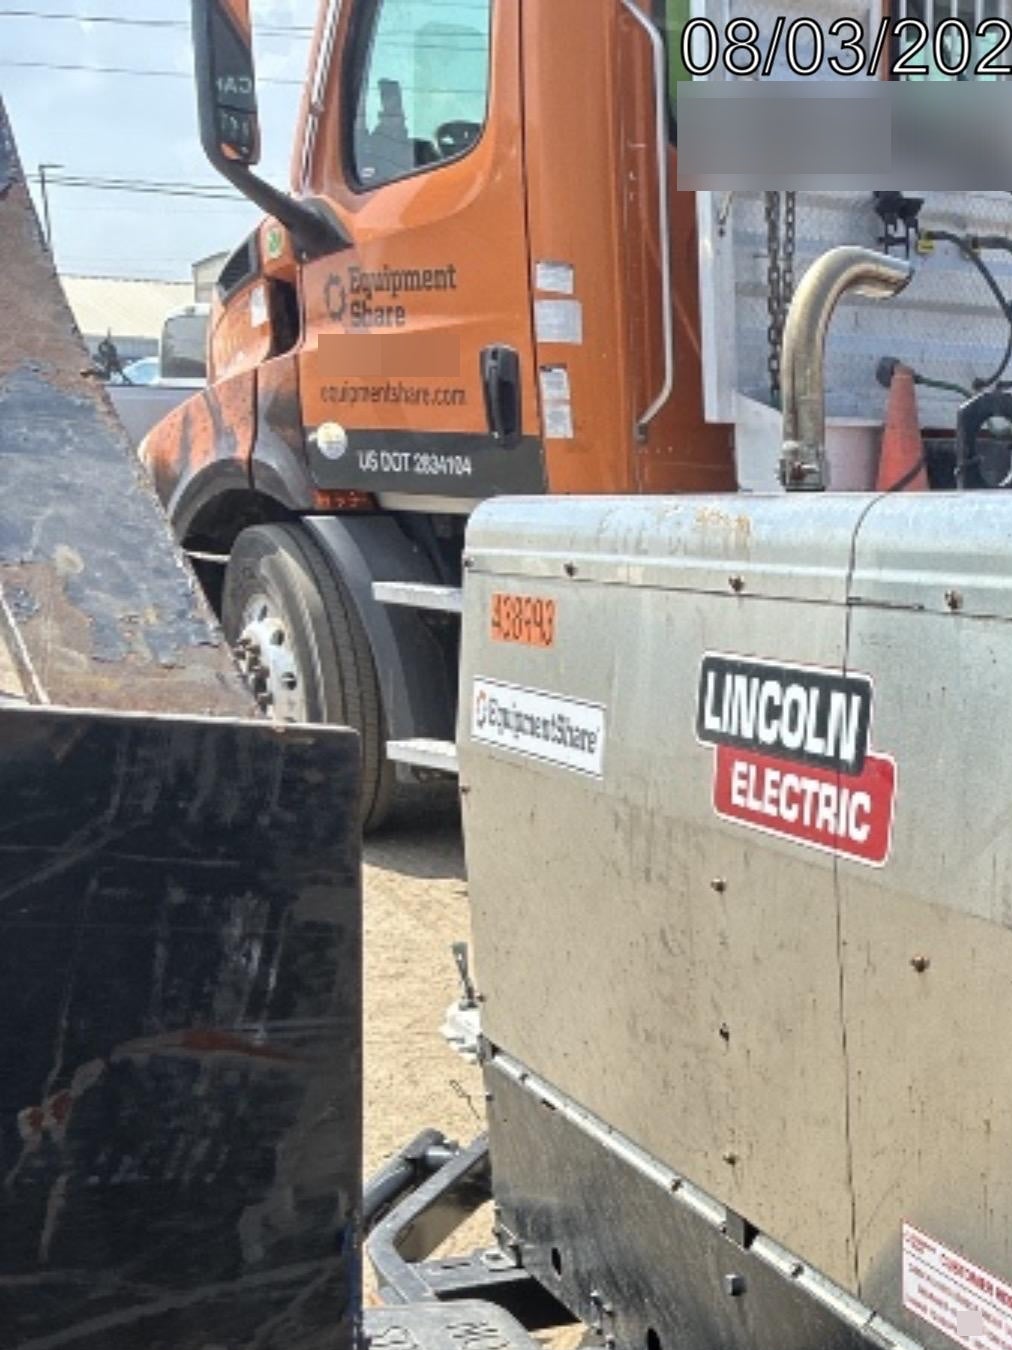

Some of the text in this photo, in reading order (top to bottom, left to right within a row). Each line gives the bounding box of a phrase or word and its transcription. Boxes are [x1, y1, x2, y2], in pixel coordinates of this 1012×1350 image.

[348, 265, 456, 299] Equipment
[351, 300, 406, 327] Share
[321, 381, 467, 406] equipmentshare.com
[358, 450, 379, 472] US
[380, 450, 410, 472] DOT
[488, 698, 598, 754] EquipmentShare
[704, 671, 862, 761] LINCOLN
[731, 759, 871, 843] ELECTRIC
